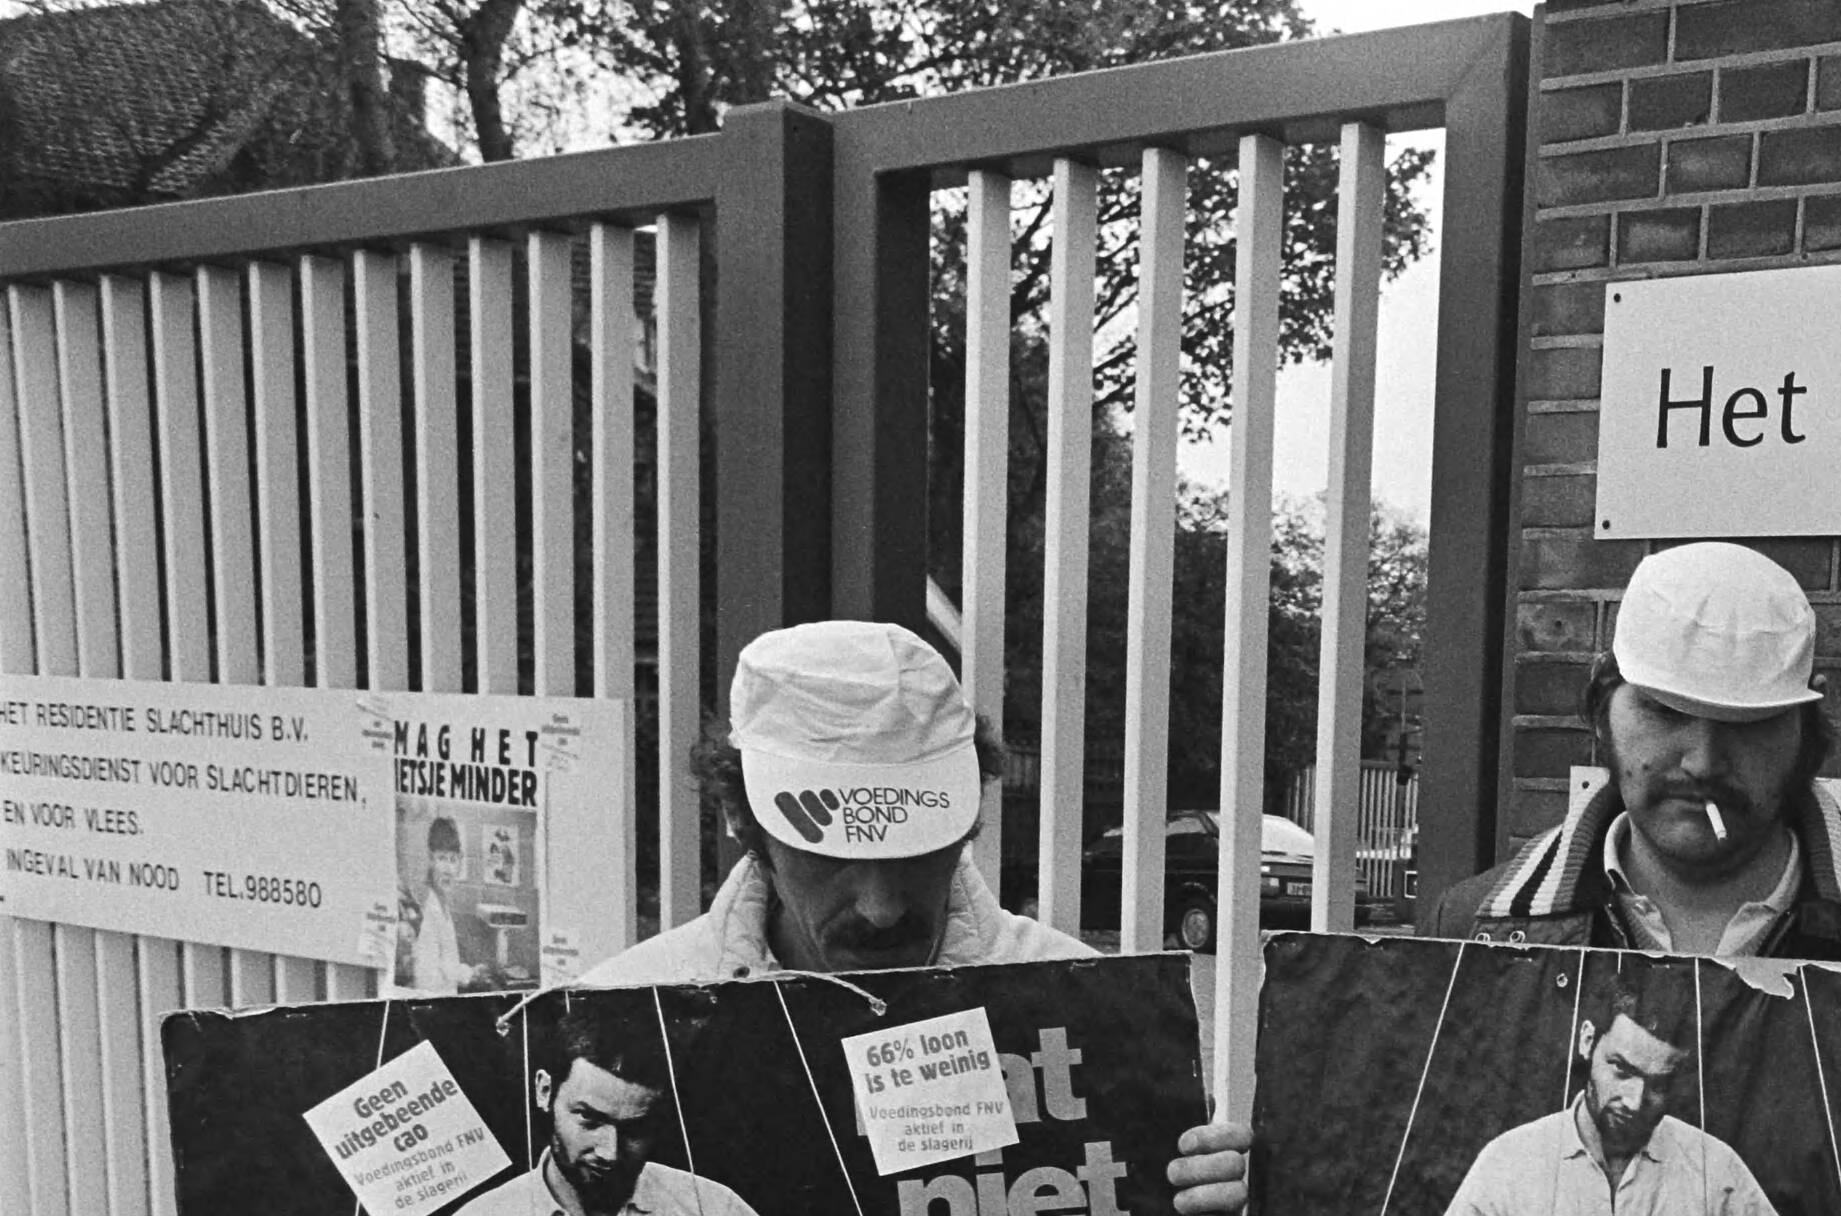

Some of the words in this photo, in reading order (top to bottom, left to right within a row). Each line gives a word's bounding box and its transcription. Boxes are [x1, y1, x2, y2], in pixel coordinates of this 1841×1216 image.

[1657, 366, 1807, 448] Het
[36, 702, 136, 732] RESIDENTIE
[146, 707, 262, 741] SLACHTHUIS
[271, 715, 309, 742] B.V.
[394, 719, 451, 760] MAG
[470, 726, 539, 767] HET
[1, 750, 141, 784] KEURINGSDIENST
[149, 760, 199, 789] VOOR
[394, 757, 446, 798] IETSJE
[449, 763, 538, 808] MINDER
[838, 787, 950, 809] VOEDINGS
[843, 807, 908, 825] BOND
[4, 800, 26, 825] EN
[30, 803, 76, 829] VOOR
[84, 807, 144, 836] VLEES.
[846, 825, 888, 843] FNV
[84, 857, 121, 884] VAN
[129, 863, 180, 891] NOOD
[866, 1037, 915, 1068] 66%
[920, 1030, 969, 1057] loon
[865, 1072, 885, 1095] is
[890, 1065, 913, 1088] te
[919, 1051, 992, 1082] weinig
[353, 1080, 408, 1119] Geen
[869, 1103, 971, 1121] Voedingsbond
[976, 1101, 1005, 1116] FNV
[333, 1078, 458, 1160] uitgebeende
[904, 1120, 945, 1136] aktief
[952, 1119, 965, 1134] in
[393, 1123, 429, 1152] cao
[899, 1138, 916, 1153] de
[920, 1136, 975, 1153] slagerij
[353, 1140, 454, 1186] Voedingsbond
[456, 1126, 485, 1149] FNV
[395, 1164, 434, 1192] aktief
[441, 1160, 456, 1175] in
[394, 1193, 413, 1209] de
